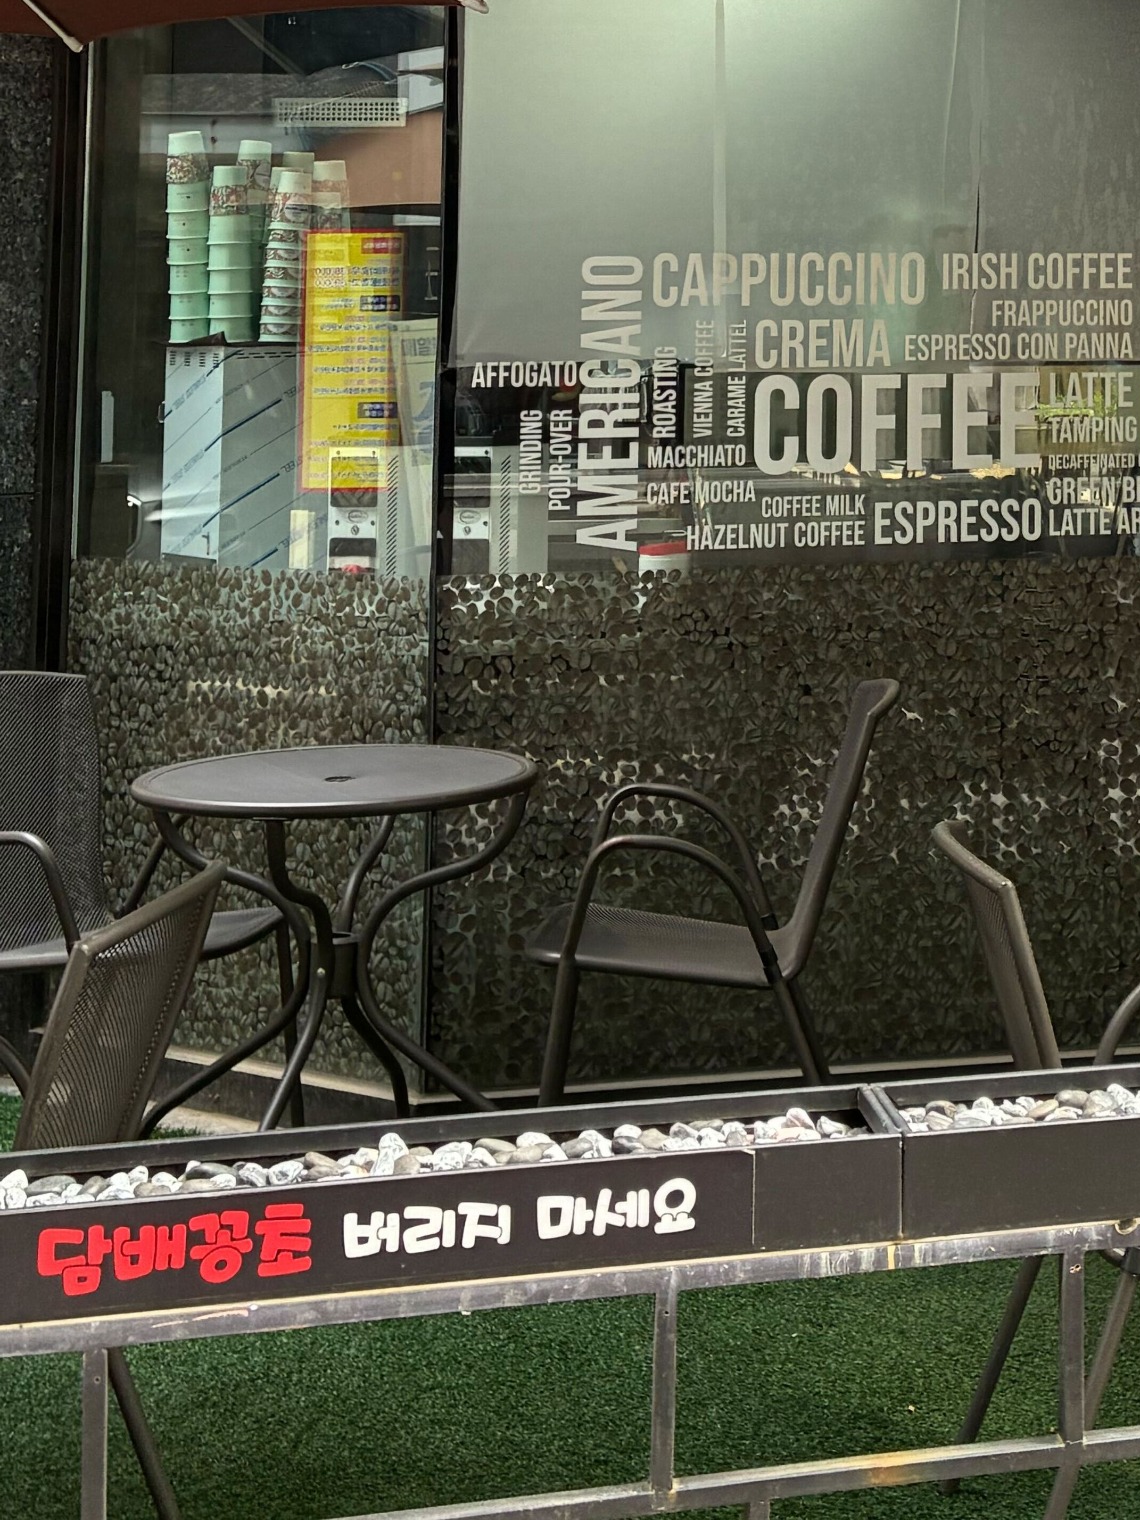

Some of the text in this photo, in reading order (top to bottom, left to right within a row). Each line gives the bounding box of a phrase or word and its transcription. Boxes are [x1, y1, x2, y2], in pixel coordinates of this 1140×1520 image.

[652, 252, 925, 307] CAPPUCCINO
[942, 252, 1133, 290] IRISH COFFEE
[991, 299, 1133, 327] FRAPPUCCINO
[754, 318, 891, 369] CREMA
[905, 332, 1133, 361] ESPRESSO CON PANNA
[471, 360, 577, 388] AFFOGATO
[652, 346, 677, 438] ROASTING
[693, 320, 714, 438] VIENNA COFFEE
[1050, 371, 1134, 408] LATTE
[576, 255, 643, 552] AMERICANO
[727, 376, 746, 437] CARAME
[753, 373, 1041, 476] COFFEE
[1050, 416, 1138, 443] TAMPING
[519, 410, 543, 495] GRINDING
[549, 409, 573, 511] POUR-OVER
[647, 444, 746, 468] MACCHIATO
[1048, 453, 1135, 470] DECAFFEINATED
[647, 480, 756, 505] CAFE MOCHA
[761, 494, 866, 518] COFFEE MILK
[1048, 477, 1117, 505] GREEN
[686, 521, 866, 551] HAZELNUT COFFEE
[874, 498, 1042, 545] ESPRESSO
[1049, 508, 1111, 537] LATTE
[37, 1177, 697, 1297] 담배꽁초 버리지 마세요
